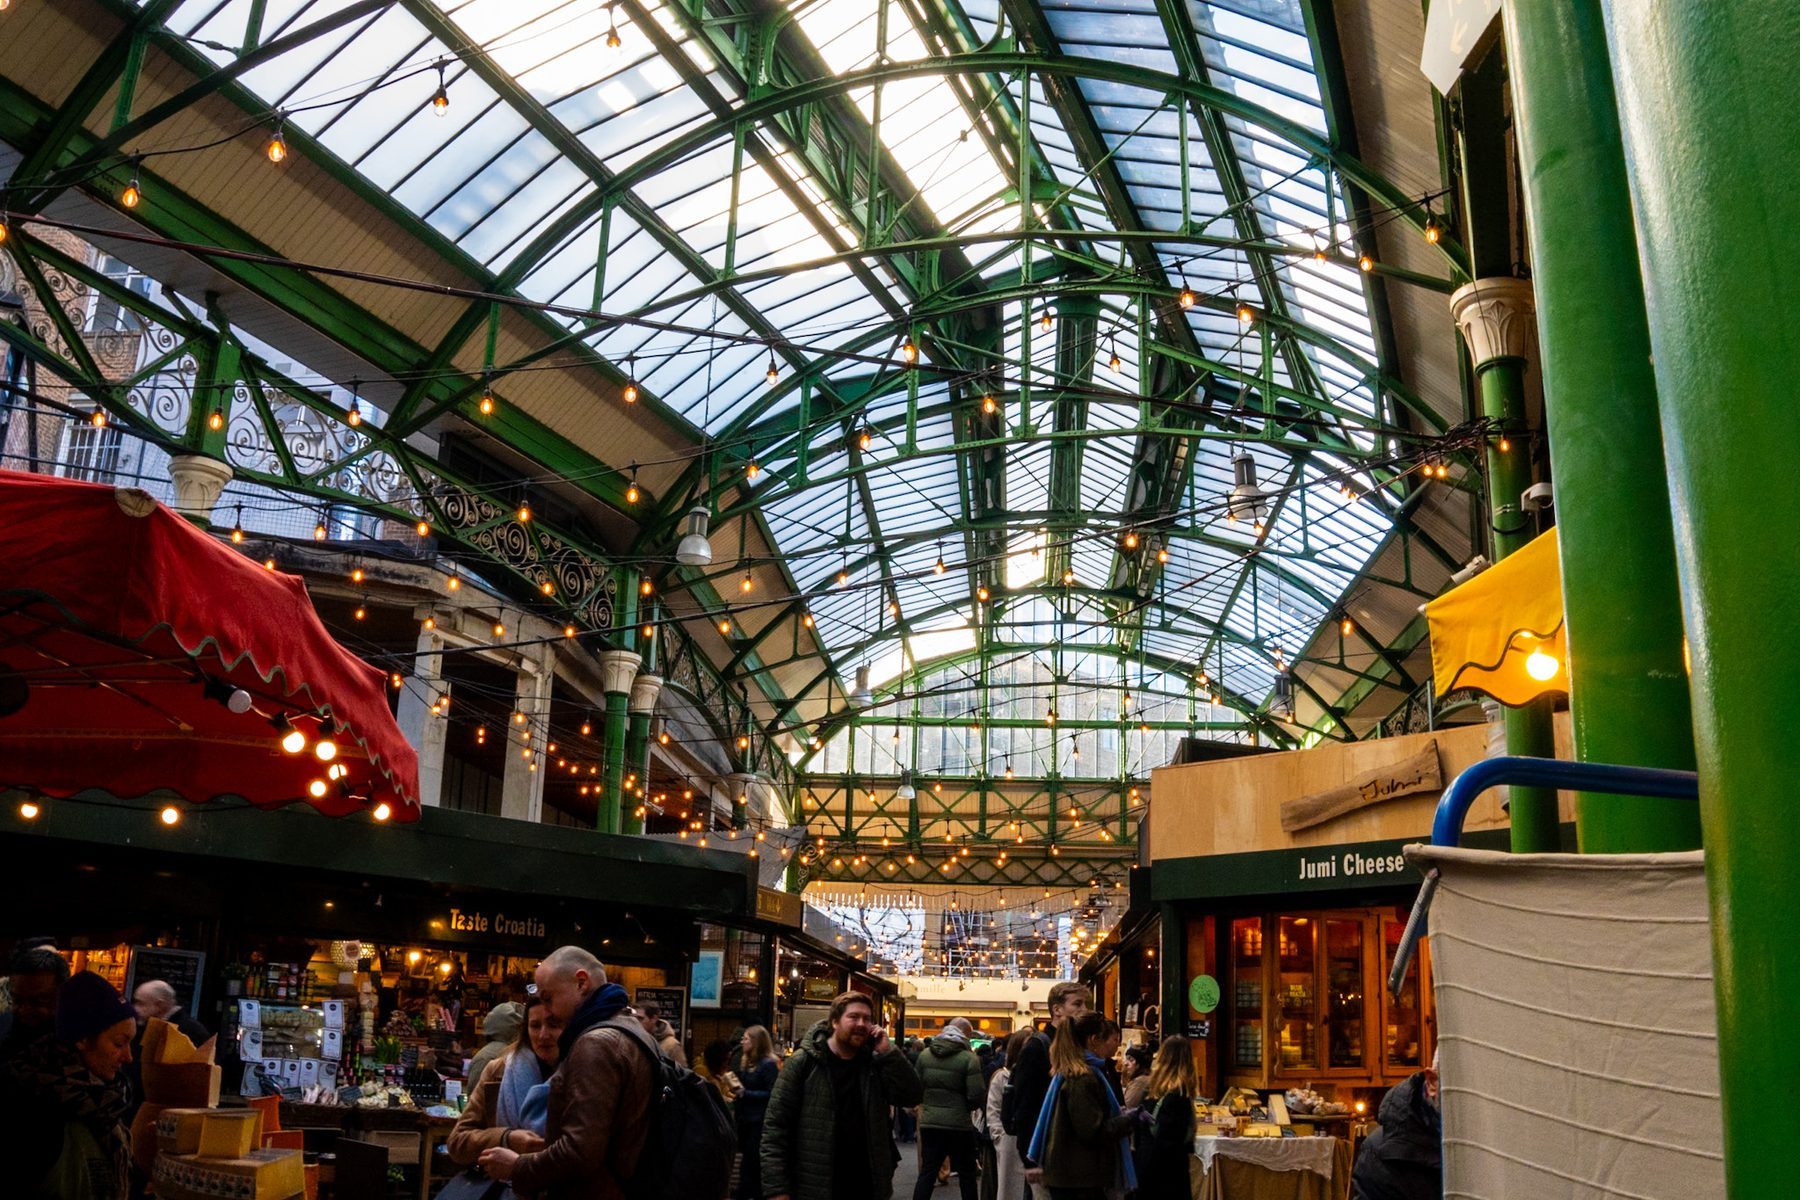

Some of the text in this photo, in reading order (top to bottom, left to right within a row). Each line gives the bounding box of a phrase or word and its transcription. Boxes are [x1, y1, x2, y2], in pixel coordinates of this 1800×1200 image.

[1299, 852, 1404, 879] Jumi Cheese
[450, 908, 545, 937] Taste Croatia
